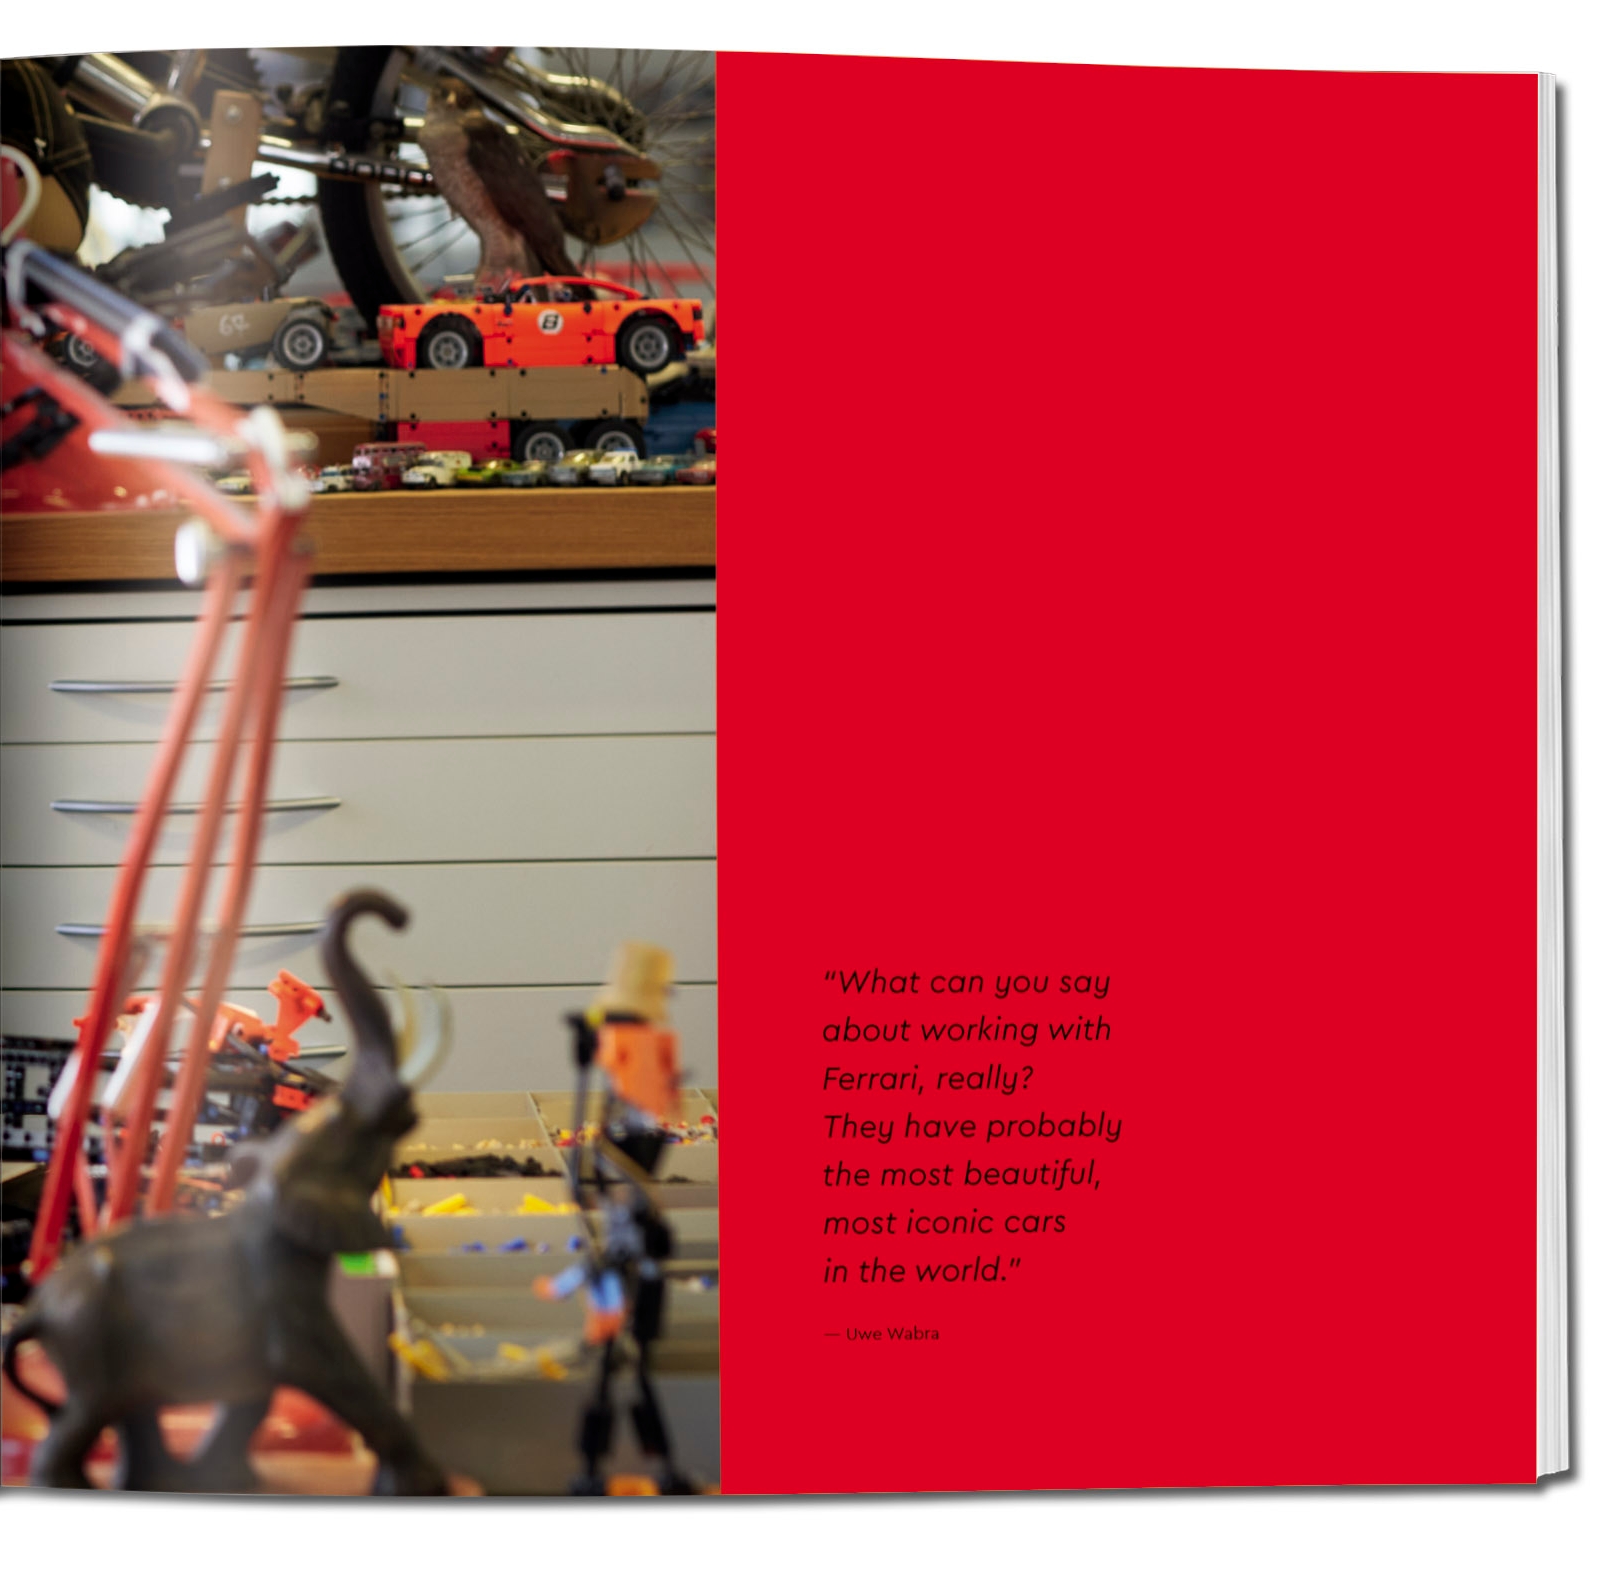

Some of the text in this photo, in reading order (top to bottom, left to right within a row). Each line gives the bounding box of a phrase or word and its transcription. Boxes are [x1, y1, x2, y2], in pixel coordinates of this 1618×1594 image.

[930, 975, 984, 995] can
[994, 975, 1049, 1000] you
[1059, 975, 1110, 1000] say
[823, 1014, 1111, 1047] about working with
[823, 1063, 1035, 1096] Ferrari, really?
[824, 1110, 1122, 1144] They have probably
[823, 1158, 1100, 1192] the most beautiful,
[823, 1208, 1066, 1236] most iconic cars
[823, 1257, 848, 1284] in
[859, 1256, 906, 1283] the
[846, 1327, 882, 1341] Uwe
[887, 1325, 940, 1341] Wabra
